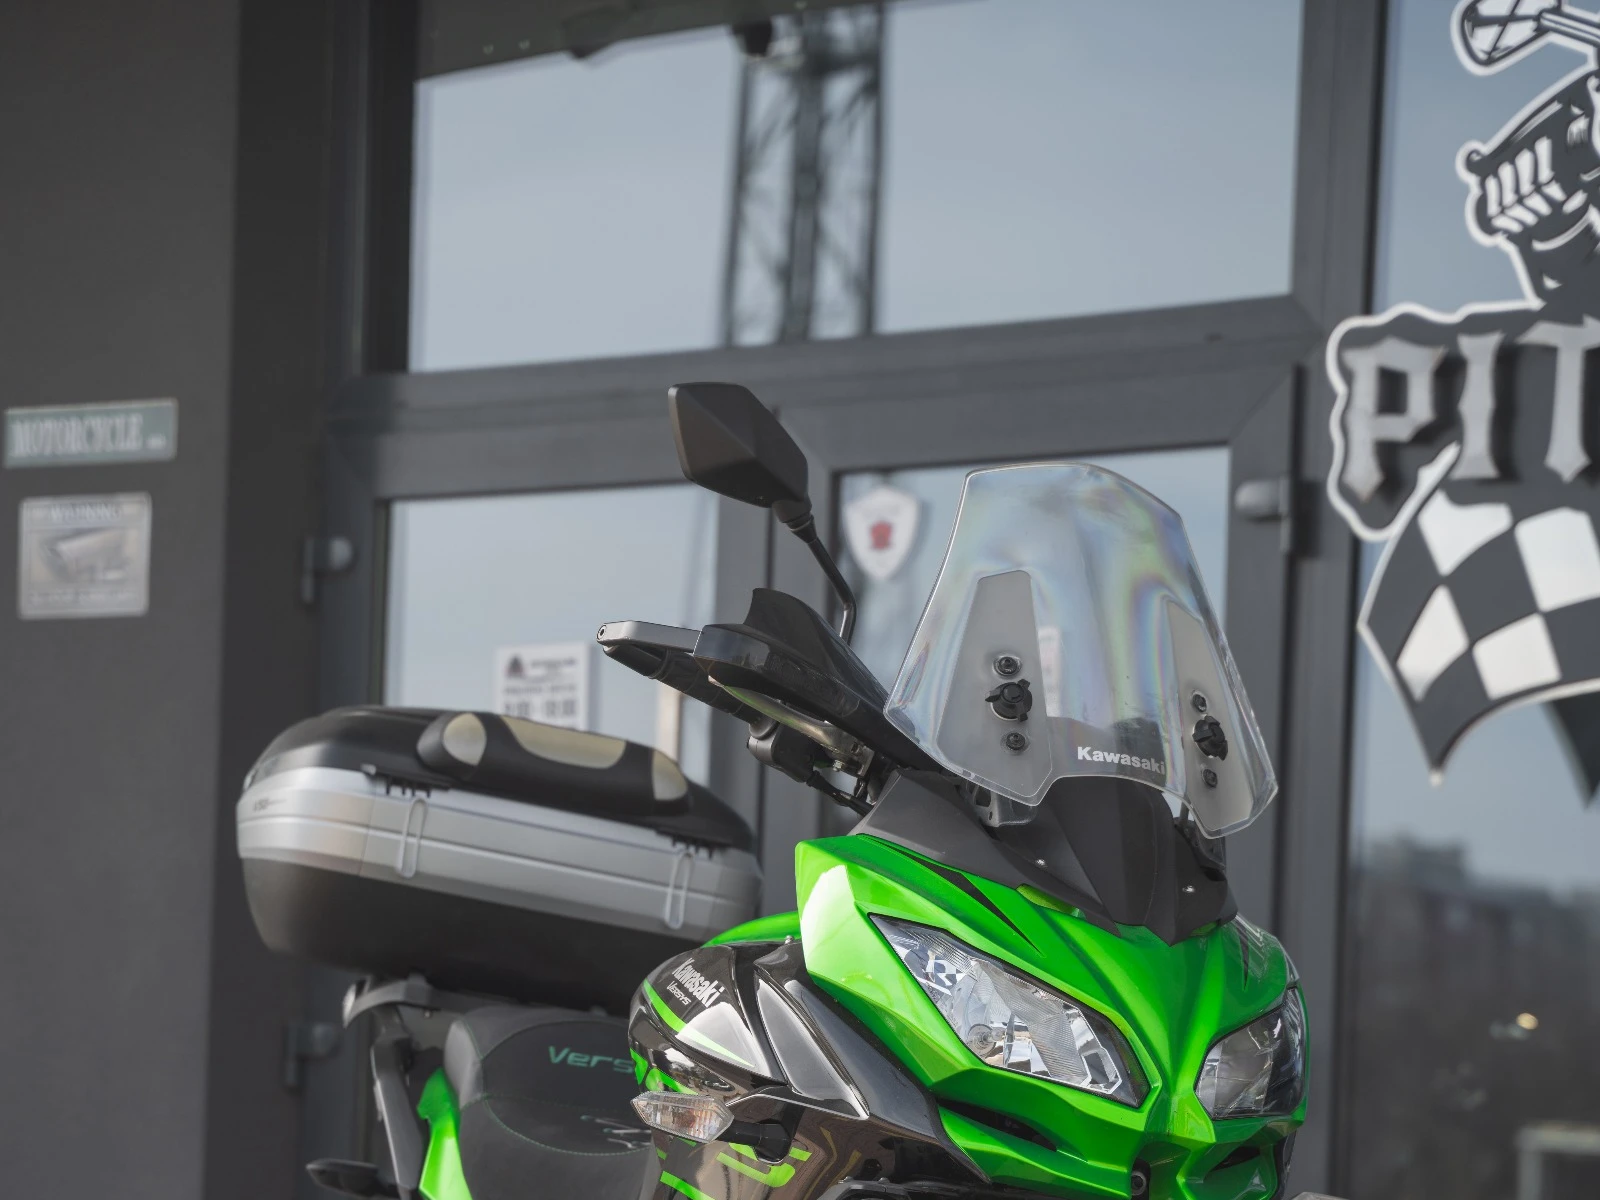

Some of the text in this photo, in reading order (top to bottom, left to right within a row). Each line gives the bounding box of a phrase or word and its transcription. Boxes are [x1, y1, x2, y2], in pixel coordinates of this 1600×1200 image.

[1342, 315, 1600, 502] PIT
[1077, 746, 1166, 775] Kawasaki
[672, 957, 725, 1008] Kawasaki
[548, 1045, 634, 1073] Vers
